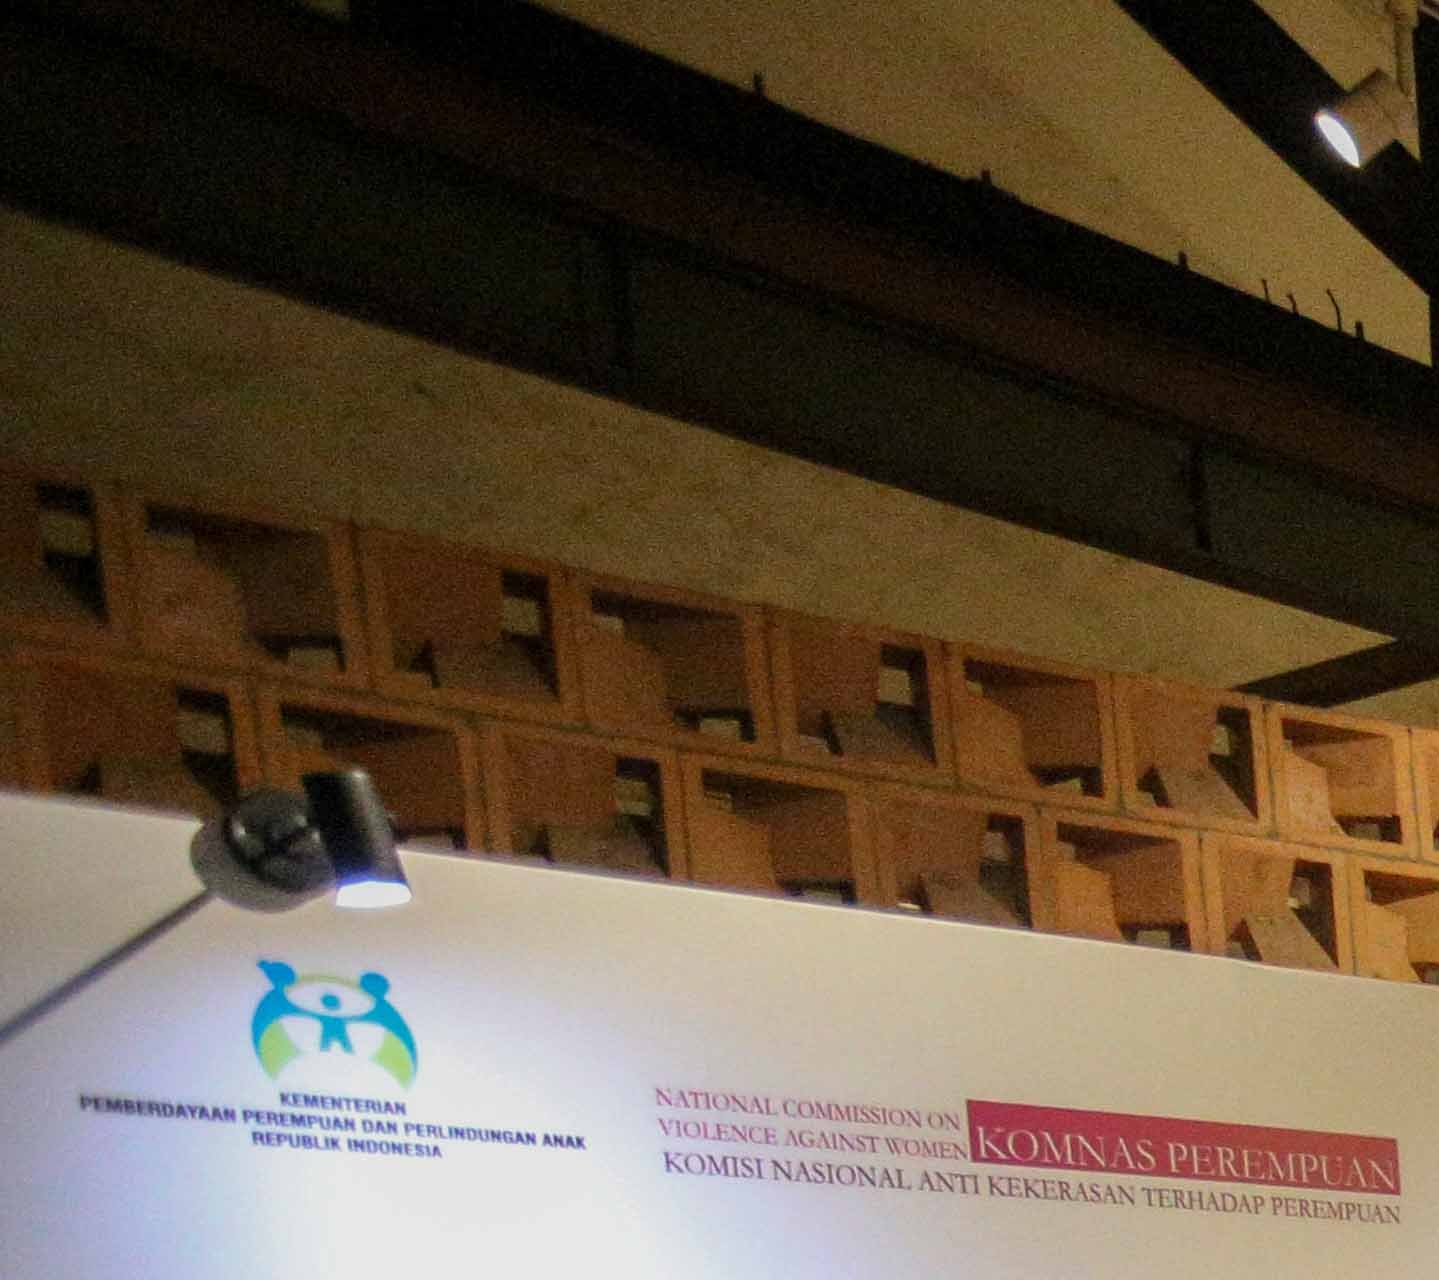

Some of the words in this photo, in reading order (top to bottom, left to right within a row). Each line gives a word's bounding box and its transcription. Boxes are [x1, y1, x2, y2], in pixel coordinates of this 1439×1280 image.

[79, 1095, 237, 1124] PEMBERDAYAAN
[242, 1109, 357, 1134] PEREMPUAN
[361, 1118, 398, 1136] DAN
[403, 1121, 538, 1146] PERLINDUNGAN
[542, 1133, 587, 1151] ANAK
[279, 1091, 407, 1117] KEMENTERIAN
[655, 1087, 779, 1115] NATIONAL
[782, 1099, 923, 1130] COMMISSION
[926, 1111, 961, 1131] ON
[251, 1130, 342, 1152] REPUBLIK
[347, 1137, 443, 1159] INDONESIA
[657, 1117, 778, 1146] VIOLENCE
[785, 1128, 880, 1154] AGAINST
[885, 1137, 970, 1160] WOMEN
[976, 1125, 1157, 1171] KOMNAS
[1167, 1141, 1398, 1190] PEREMPUAN
[663, 1151, 765, 1180] KOMISI
[769, 1159, 912, 1192] NASIONAL
[918, 1171, 980, 1195] ANTI
[988, 1177, 1136, 1207] KEKERASAN
[1140, 1187, 1266, 1216] TERHADAP
[1271, 1199, 1402, 1225] PEREMPUAN
